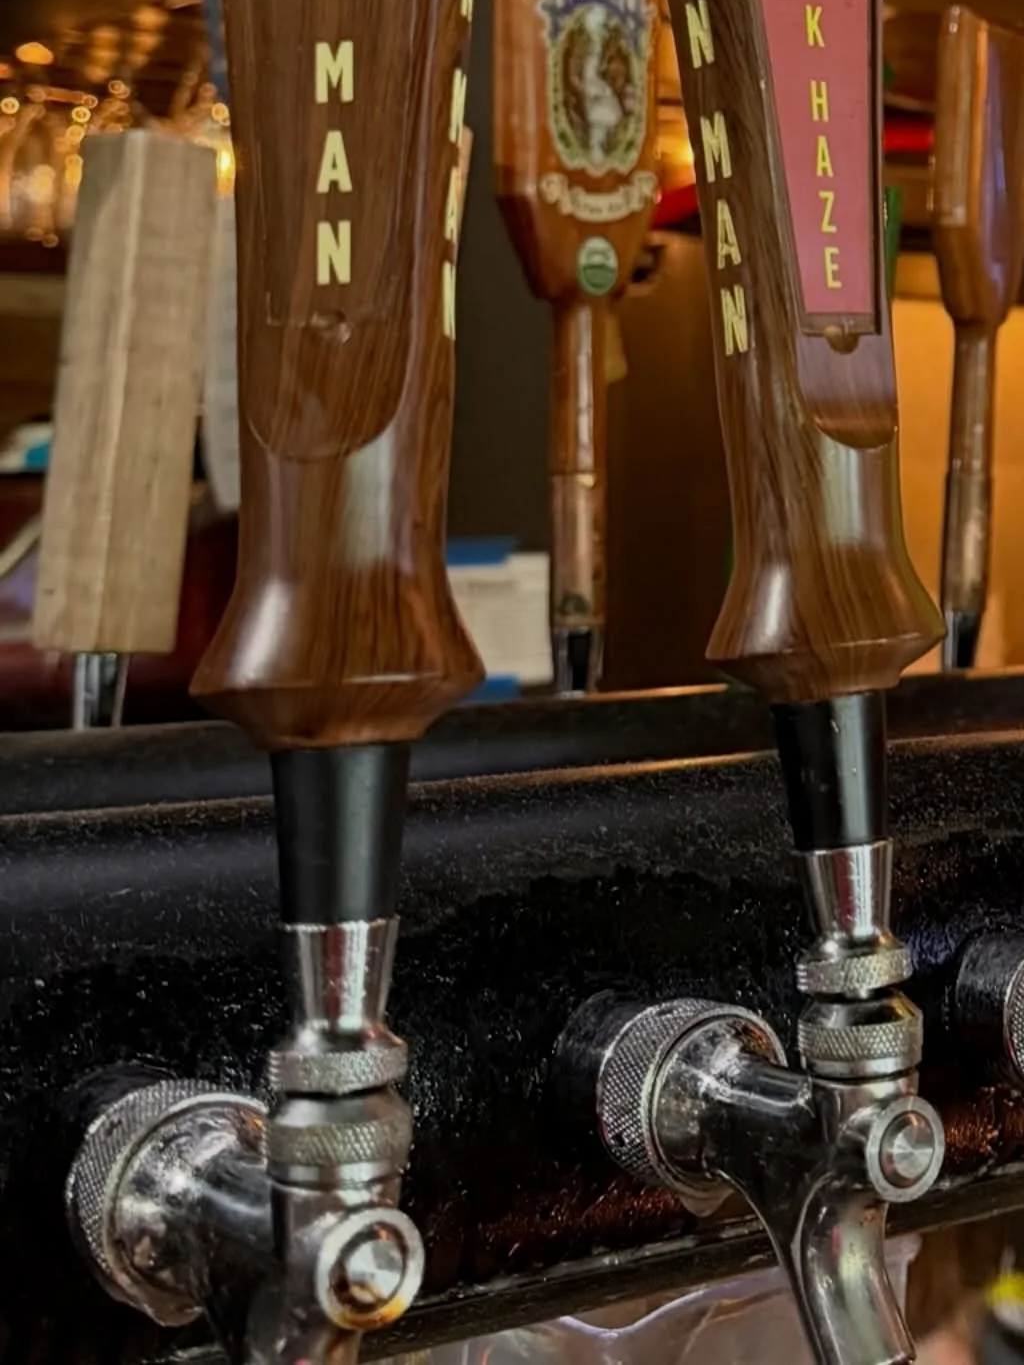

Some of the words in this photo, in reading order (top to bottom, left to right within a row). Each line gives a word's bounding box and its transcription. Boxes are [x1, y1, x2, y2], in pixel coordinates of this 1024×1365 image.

[315, 40, 354, 285] MAN
[700, 111, 748, 356] MAN
[810, 80, 843, 289] HAZE
